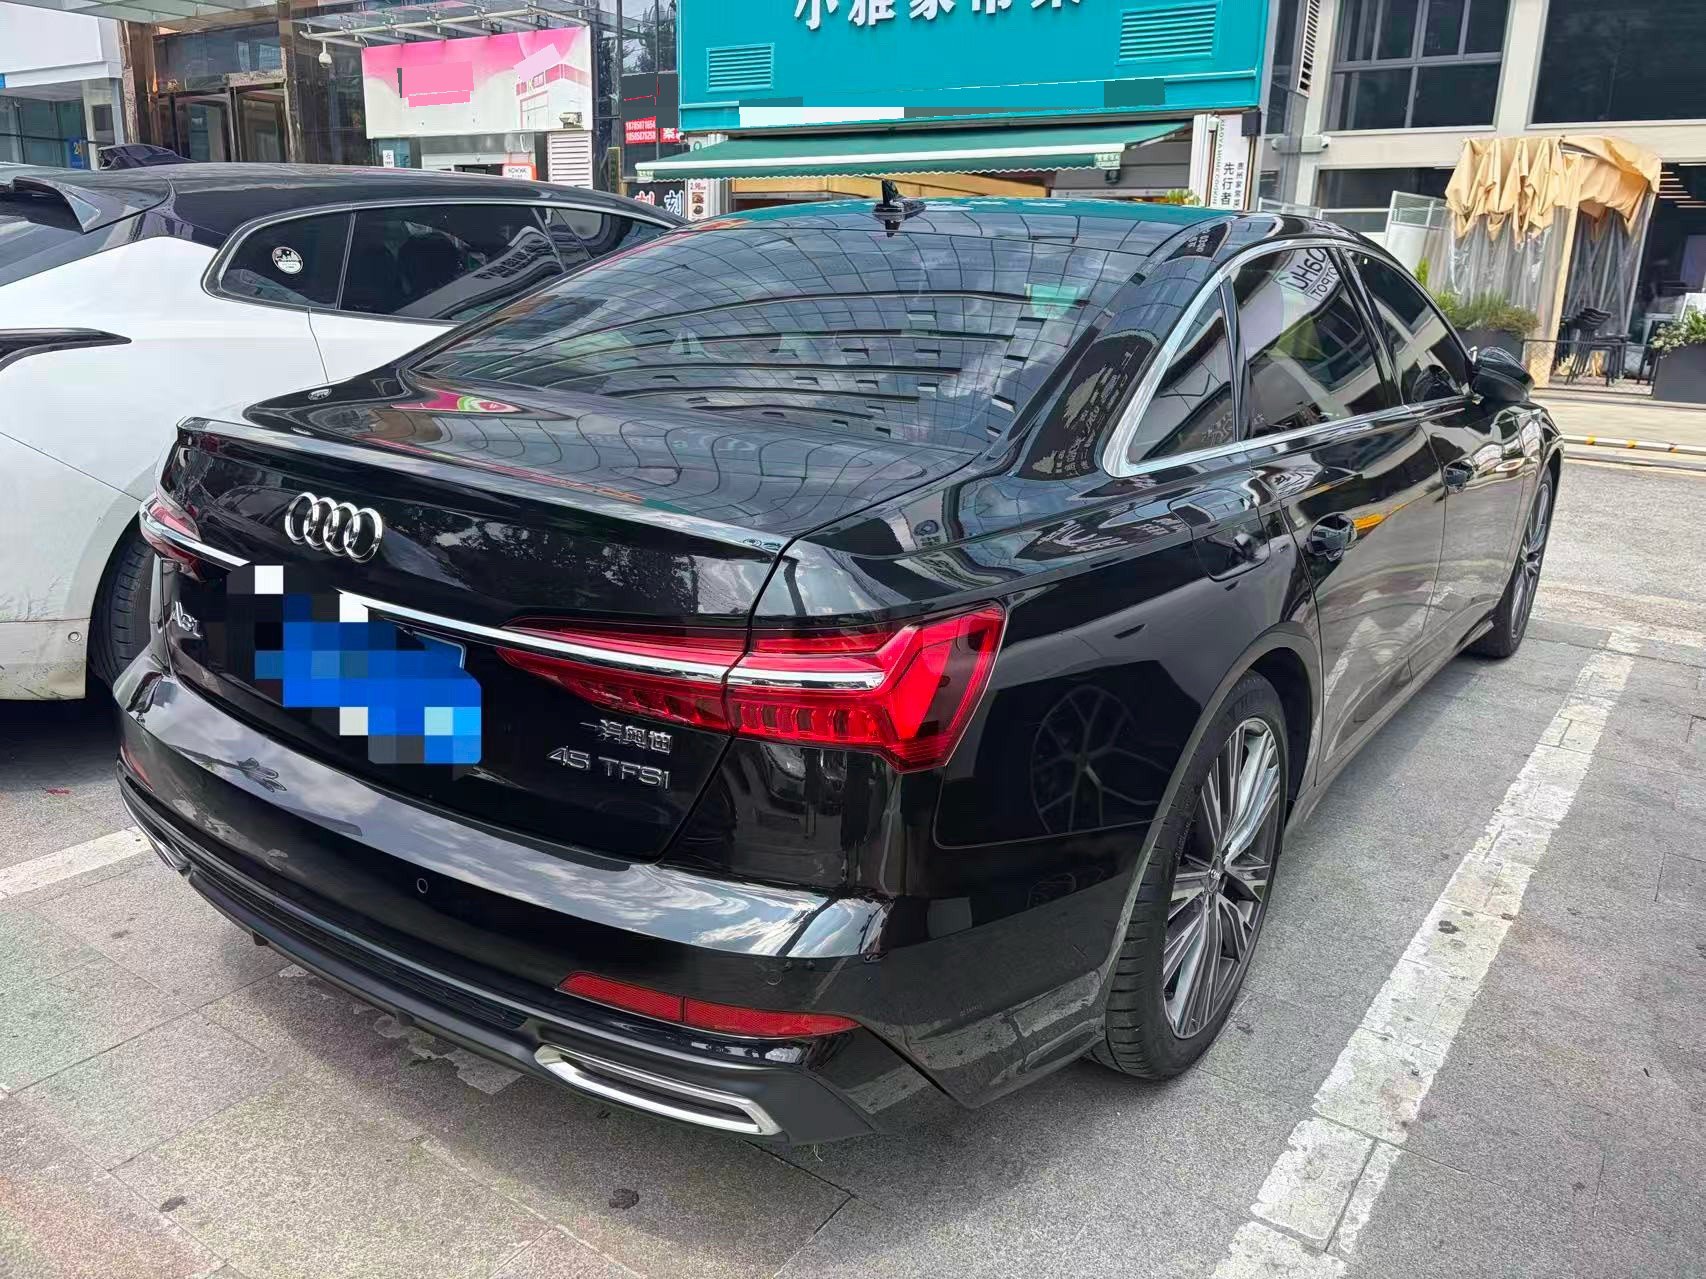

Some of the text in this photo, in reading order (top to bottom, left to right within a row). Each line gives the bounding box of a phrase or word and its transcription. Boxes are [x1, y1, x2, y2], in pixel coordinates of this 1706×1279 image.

[1220, 162, 1235, 205] 先行者
[579, 719, 673, 755] 一汽奥迪
[547, 745, 671, 789] 45 TFSI
